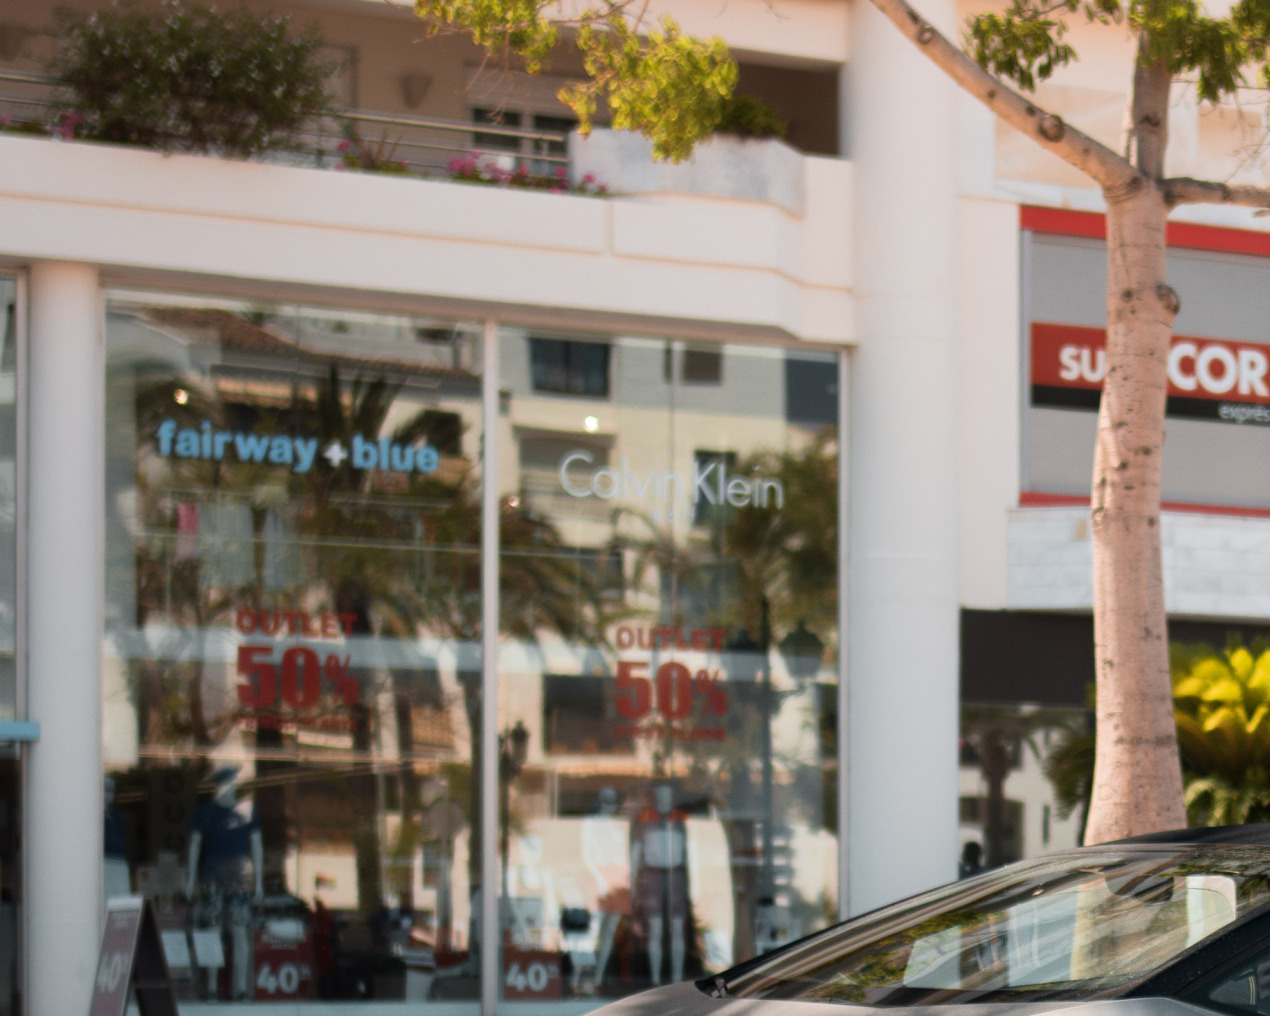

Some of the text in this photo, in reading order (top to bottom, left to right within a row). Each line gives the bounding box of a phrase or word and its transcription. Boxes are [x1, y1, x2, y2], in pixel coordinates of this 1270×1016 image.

[1058, 341, 1270, 397] SUCOR
[559, 450, 785, 510] Calvin Klein
[236, 608, 358, 638] OUTLET
[616, 626, 727, 654] OUTLET
[236, 644, 359, 710] 50%
[616, 660, 727, 721] 50%
